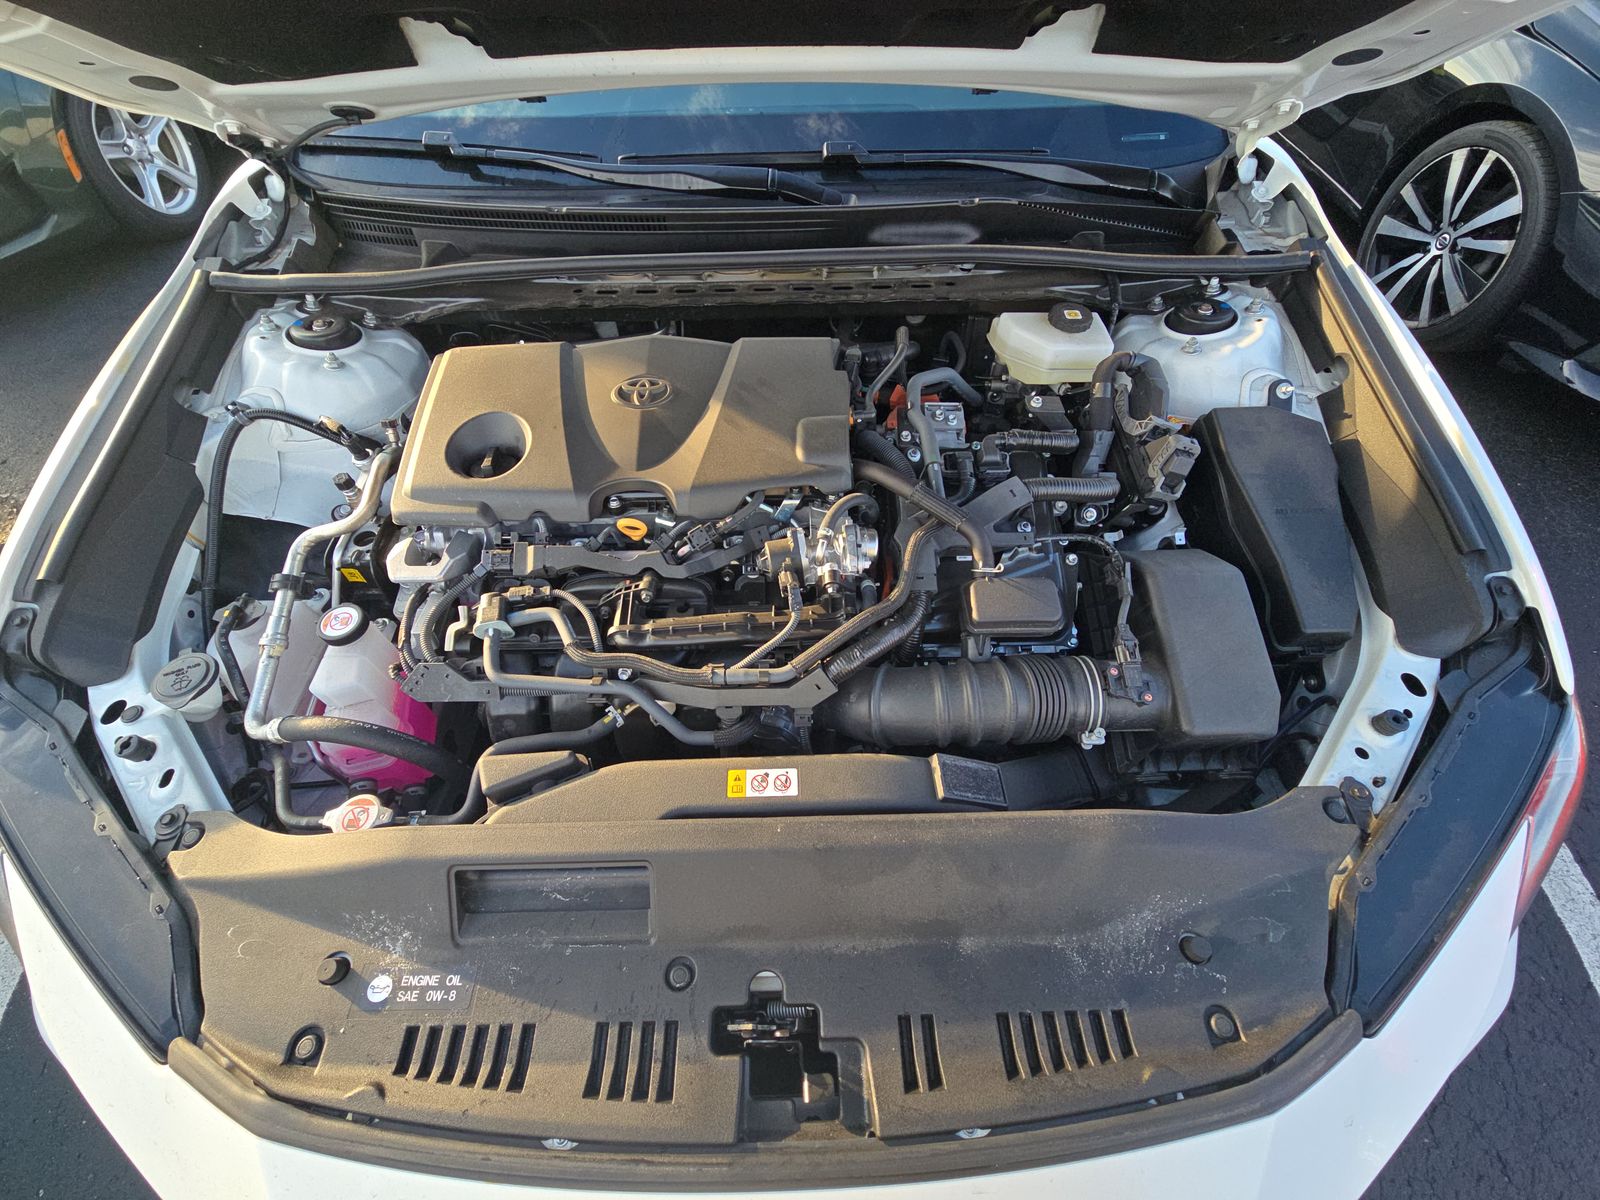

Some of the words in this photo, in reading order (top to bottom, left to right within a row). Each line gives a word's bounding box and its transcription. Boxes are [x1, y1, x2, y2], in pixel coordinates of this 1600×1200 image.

[400, 975, 441, 987] ENGINE
[445, 974, 463, 986] OIL
[396, 990, 420, 1002] SAE
[425, 990, 457, 1002] 0W-8
